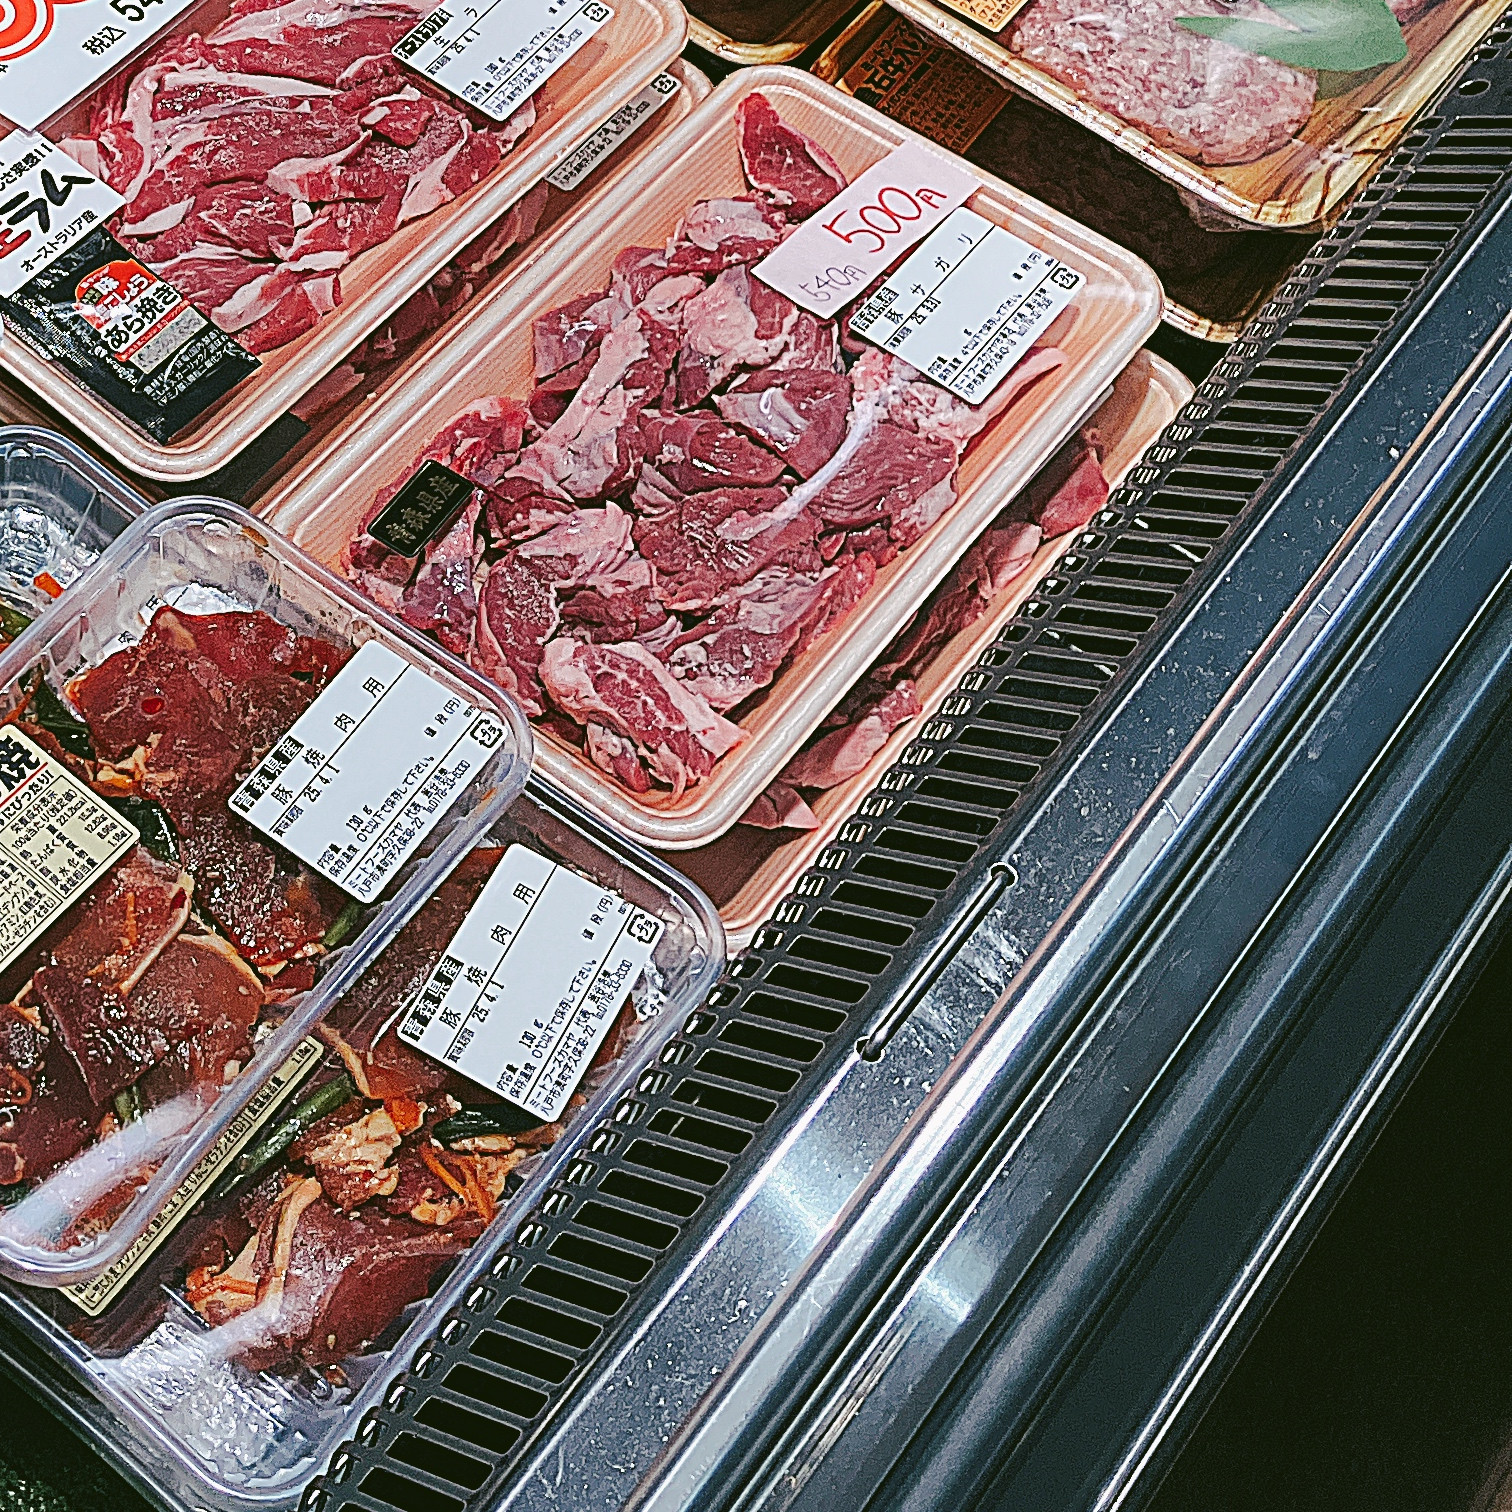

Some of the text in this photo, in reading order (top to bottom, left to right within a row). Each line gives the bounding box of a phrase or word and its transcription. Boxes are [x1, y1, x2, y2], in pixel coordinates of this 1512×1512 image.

[81, 24, 127, 57] 税込
[821, 186, 948, 253] 500円
[798, 263, 868, 303] 540円
[102, 283, 183, 352] あら挽き
[271, 676, 386, 805] 豚焼肉用
[438, 882, 536, 1030] 豚焼肉用
